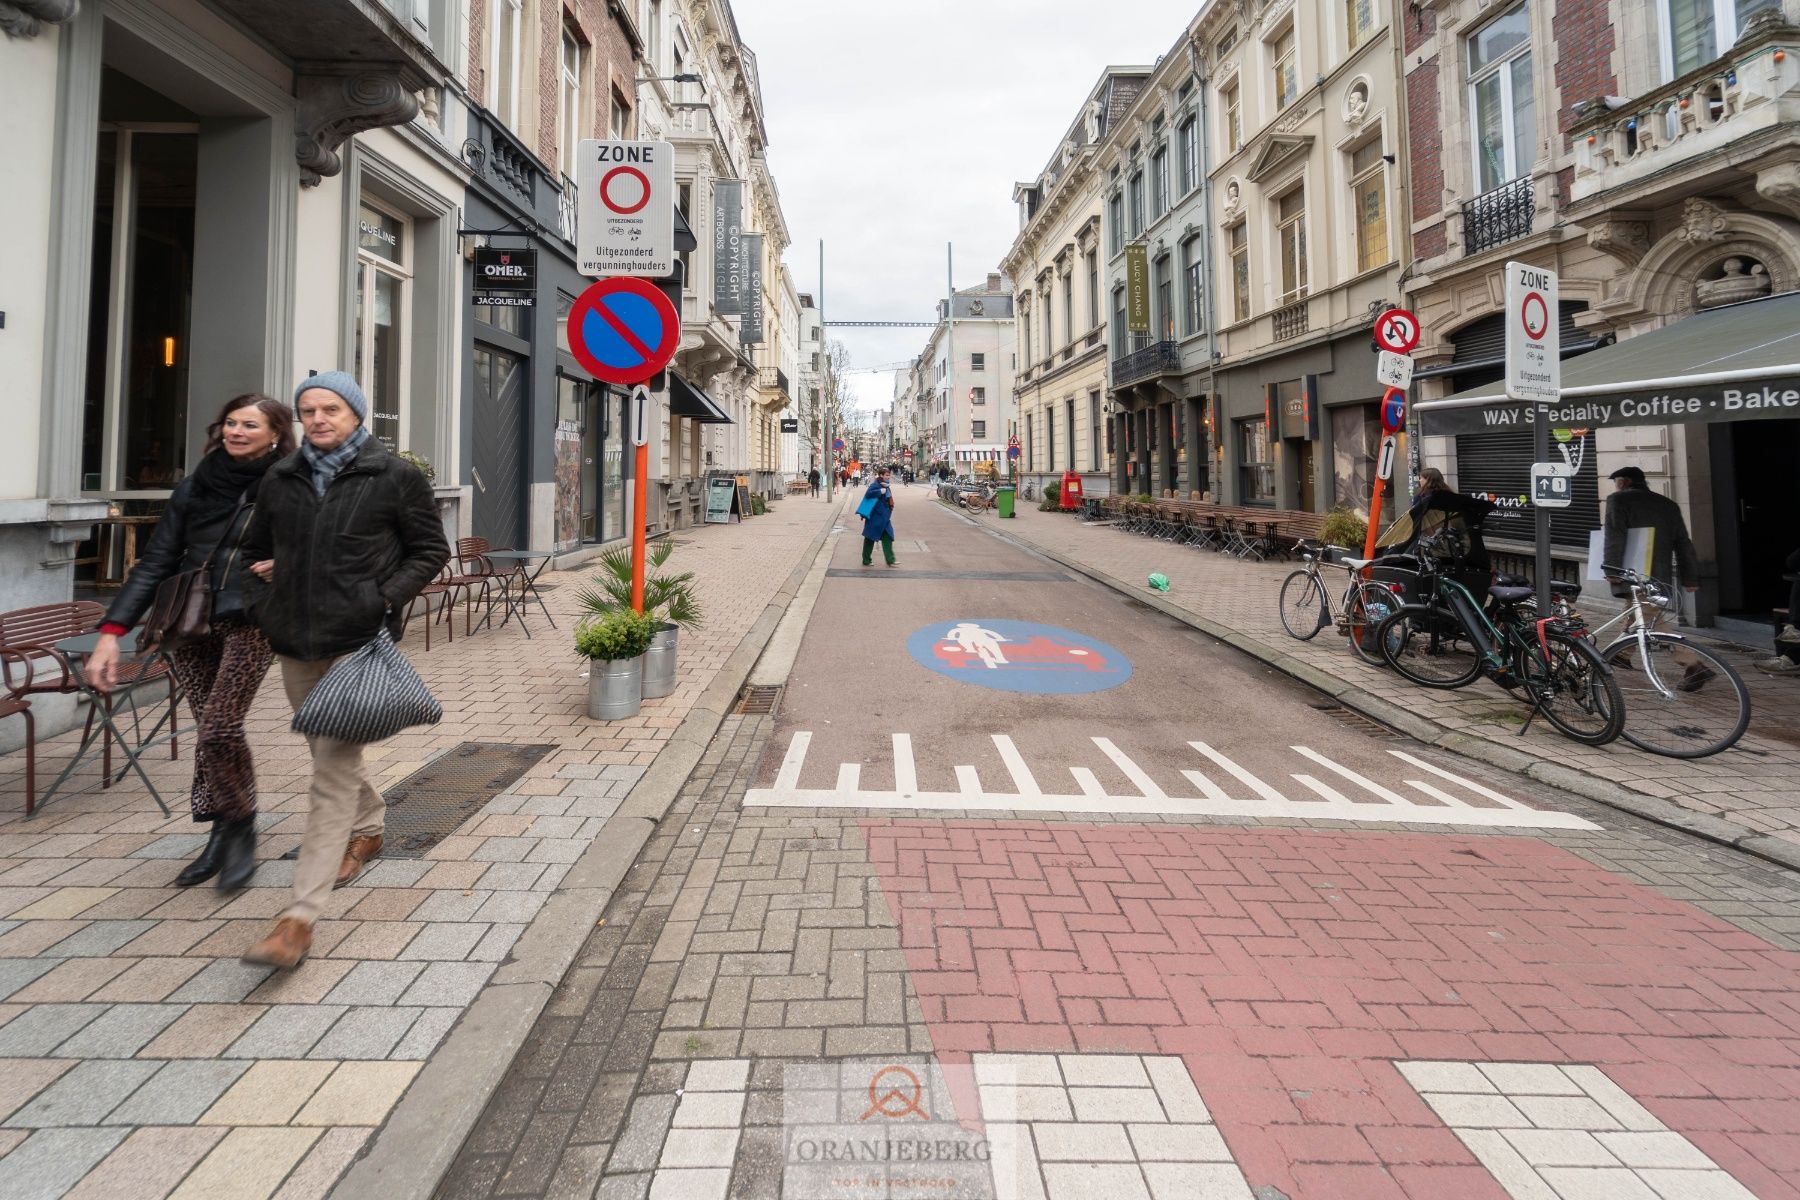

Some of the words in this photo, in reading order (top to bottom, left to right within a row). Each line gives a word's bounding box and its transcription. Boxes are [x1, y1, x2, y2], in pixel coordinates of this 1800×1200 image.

[597, 145, 654, 163] ZONE
[596, 246, 654, 259] Uitgezonderd
[583, 260, 667, 273] vergunninghouders
[1133, 260, 1141, 283] LUCY
[1520, 269, 1549, 291] ZONE
[477, 297, 533, 306] JACQUELINE
[1134, 285, 1142, 317] CHANG
[1483, 407, 1519, 425] WAY
[1525, 401, 1612, 423] Secialty
[1620, 394, 1702, 418] Coffee
[1557, 480, 1562, 489] 1
